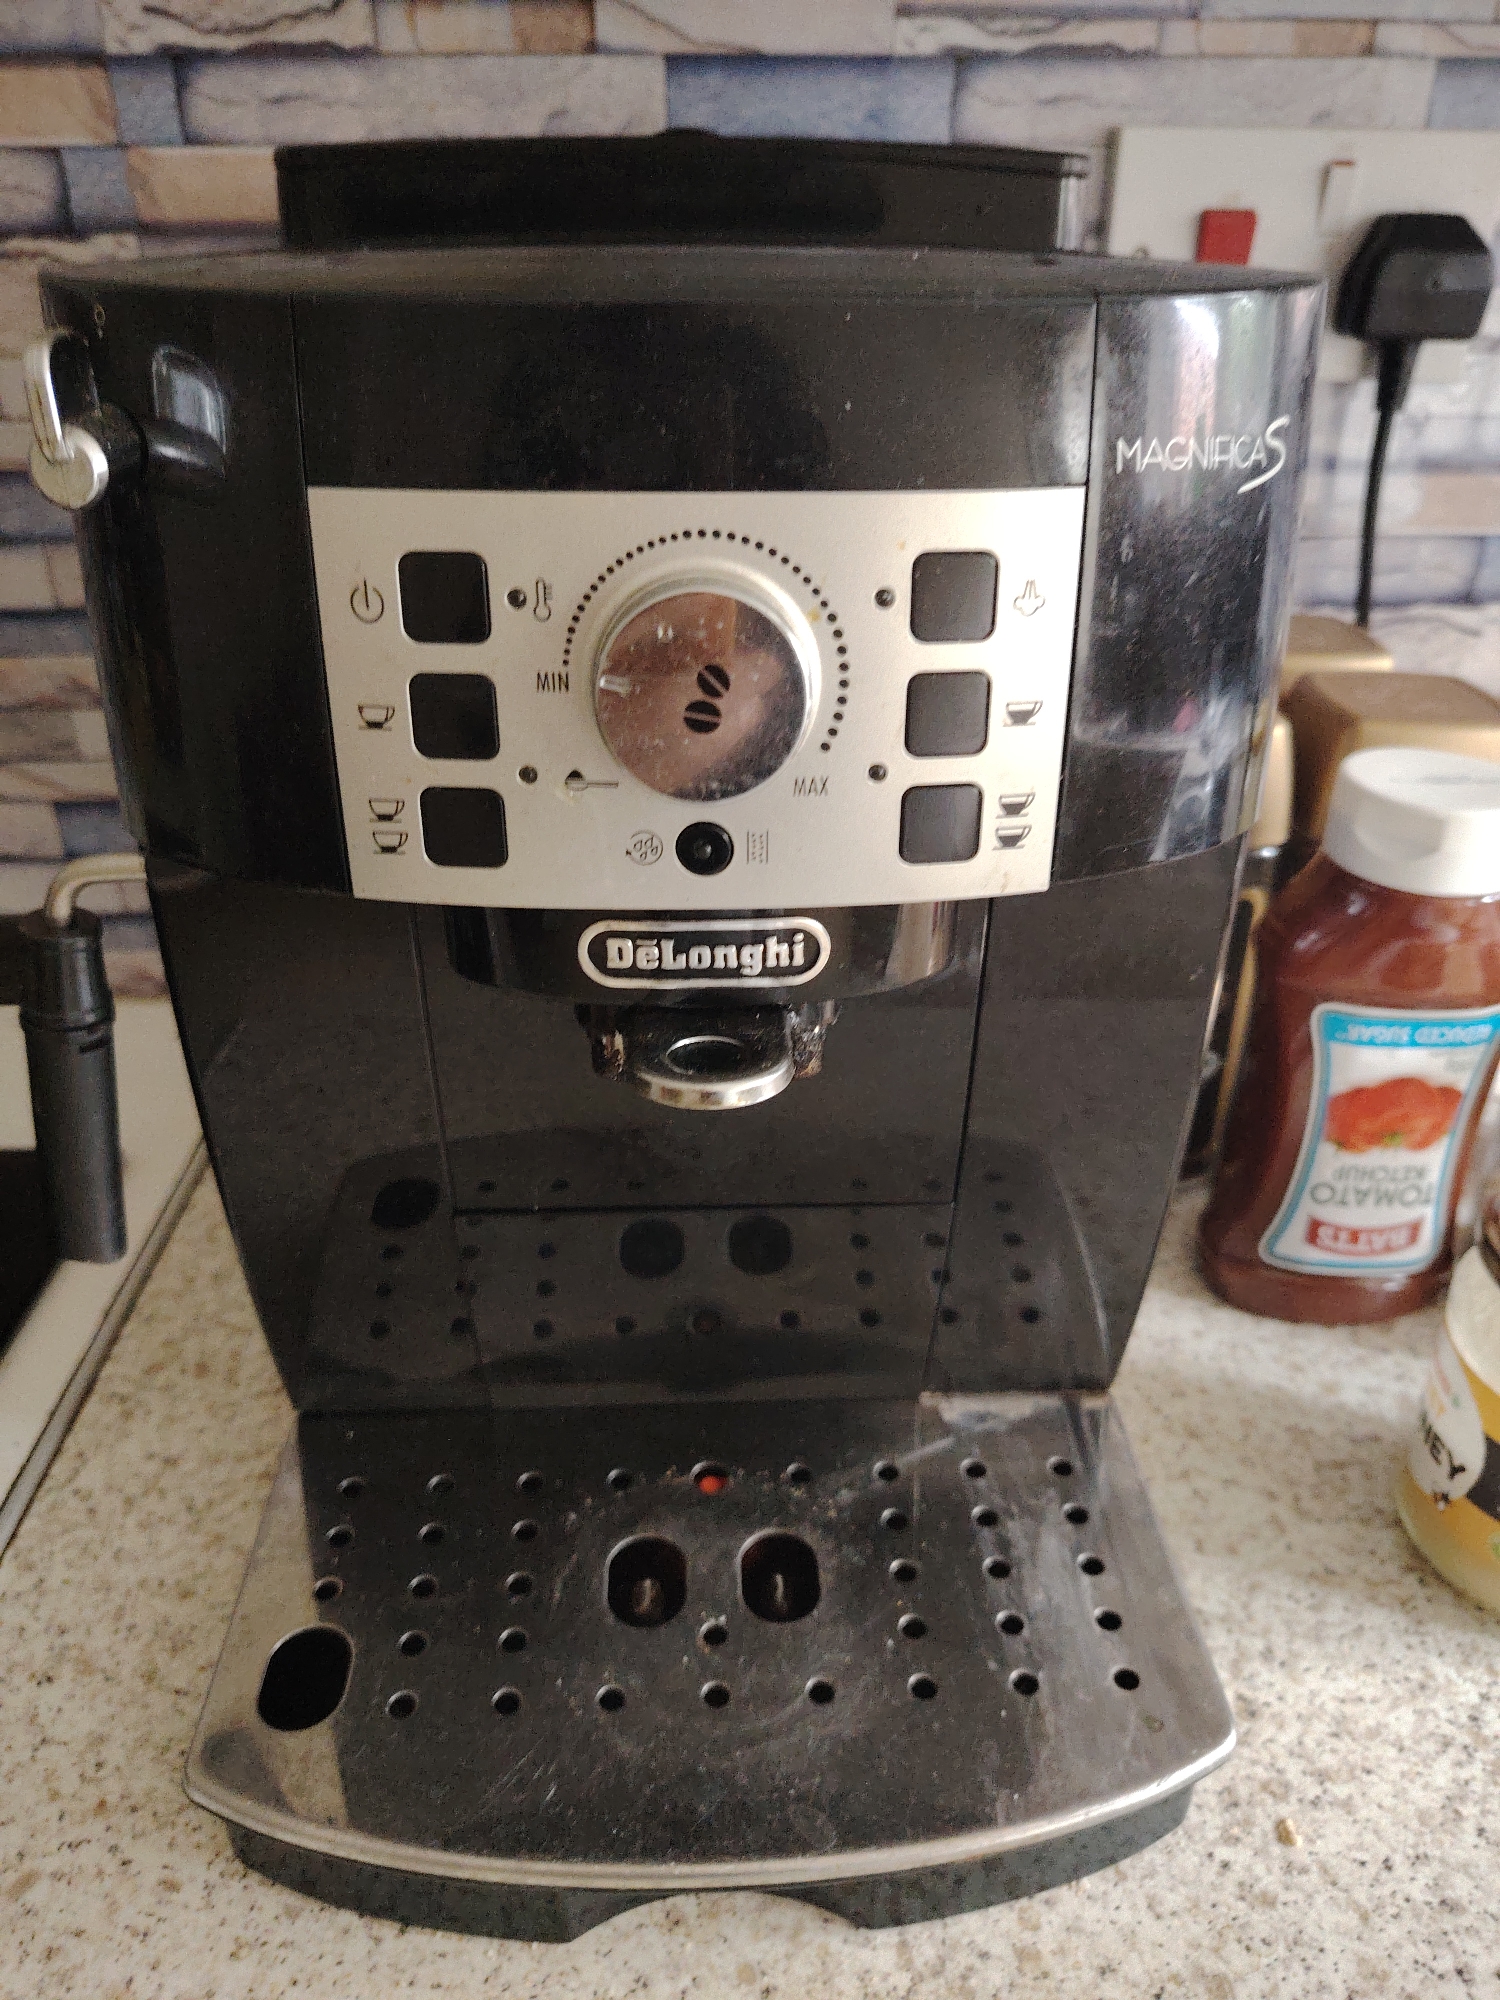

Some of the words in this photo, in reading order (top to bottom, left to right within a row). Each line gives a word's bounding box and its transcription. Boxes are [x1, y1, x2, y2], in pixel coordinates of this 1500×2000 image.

[536, 671, 570, 693] MIN
[793, 775, 829, 798] MAX
[1334, 1165, 1426, 1184] KETCHUP
[1309, 1181, 1432, 1207] TOMATO
